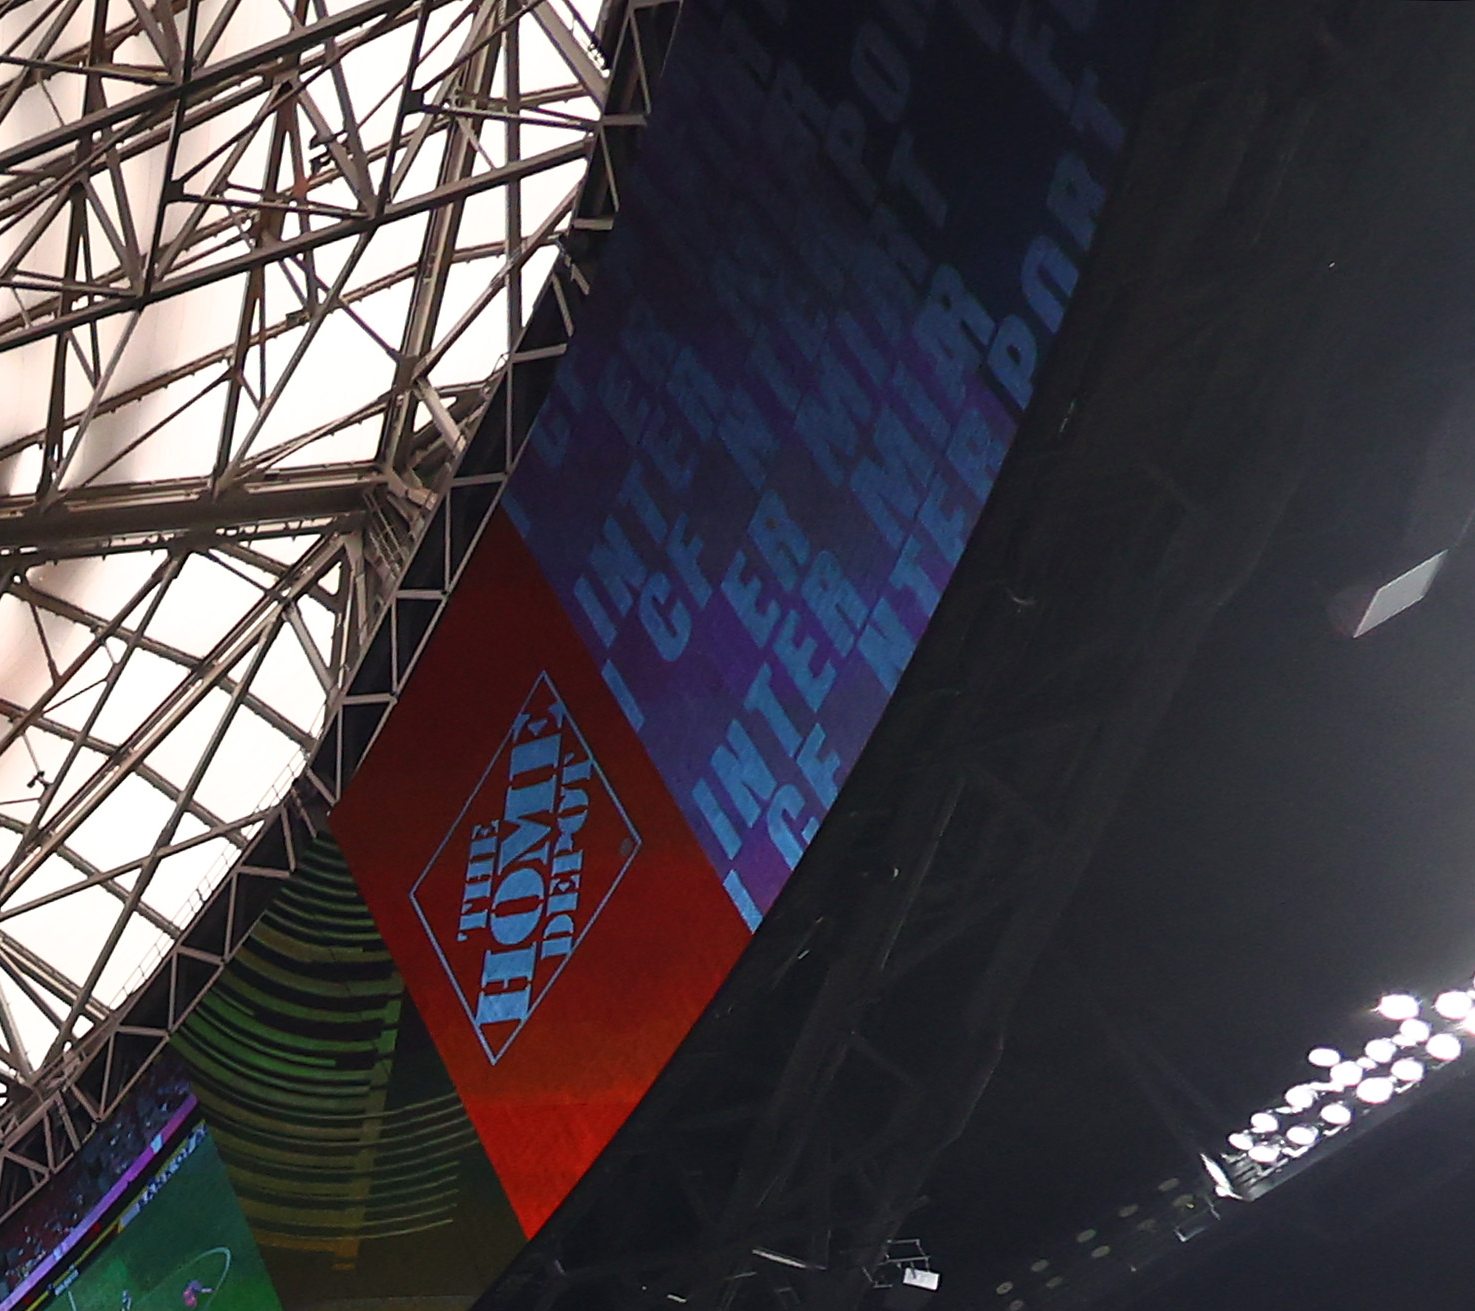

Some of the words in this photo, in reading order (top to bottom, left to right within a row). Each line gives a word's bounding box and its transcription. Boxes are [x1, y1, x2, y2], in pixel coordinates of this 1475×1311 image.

[457, 820, 499, 942] THE
[477, 701, 566, 1026] HOME
[541, 752, 594, 960] DEPOT
